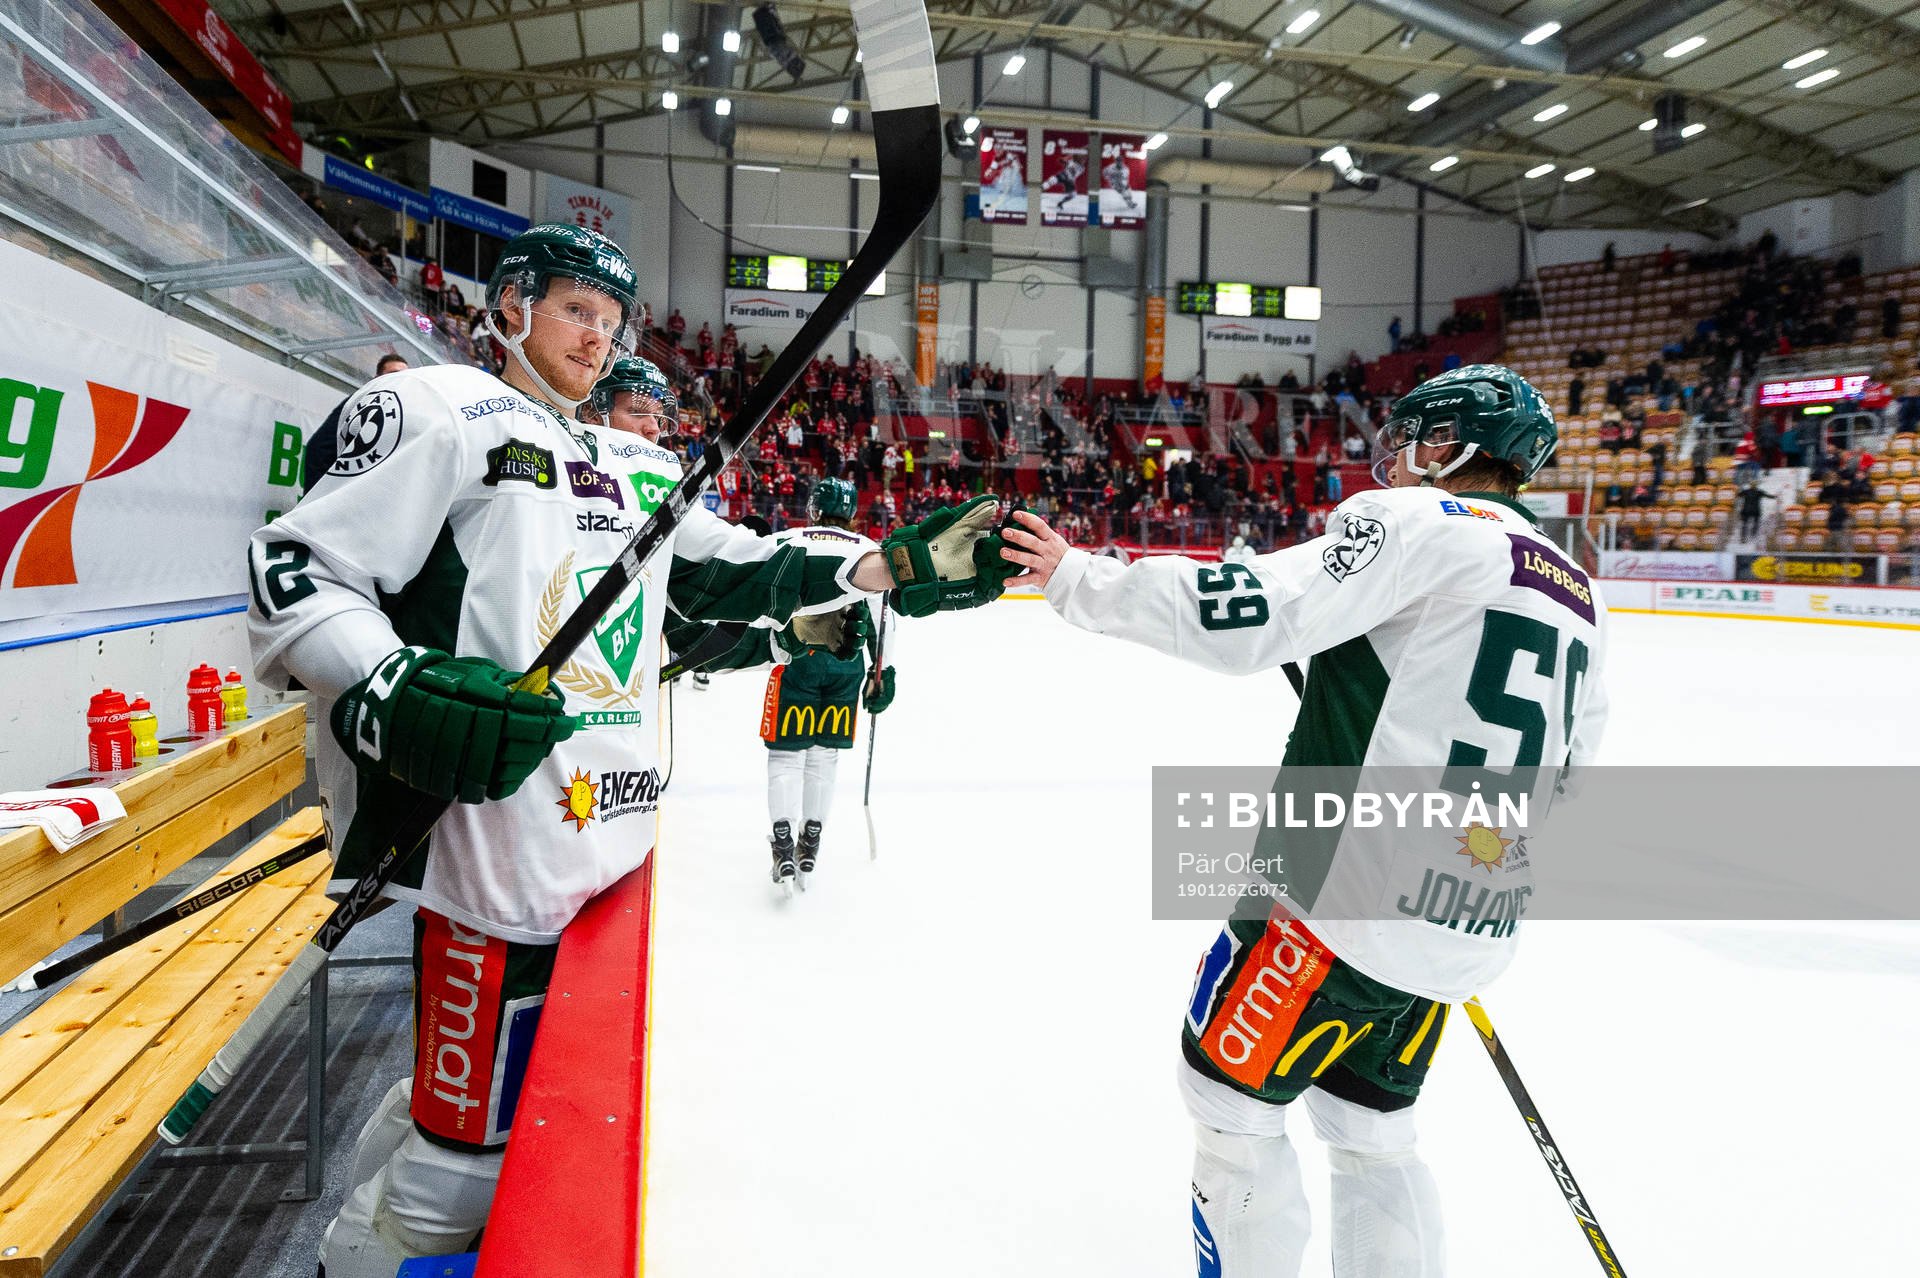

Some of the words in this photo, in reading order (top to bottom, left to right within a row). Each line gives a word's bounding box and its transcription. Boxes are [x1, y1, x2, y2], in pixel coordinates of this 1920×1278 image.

[327, 163, 382, 195] Välkommen
[503, 255, 529, 265] CCM
[730, 305, 789, 318] Faradium
[1207, 331, 1258, 342] Faradium
[1264, 333, 1292, 346] Bygg
[1295, 335, 1311, 345] AB
[1425, 396, 1464, 409] CCM
[248, 539, 318, 621] 12
[1524, 551, 1592, 606] LÖFBERGS
[1197, 563, 1269, 631] 59
[1675, 586, 1762, 601] PEAB
[207, 707, 217, 735] NERVIT
[600, 767, 660, 812] ENERG
[600, 803, 658, 824] karlstadsenergi.s
[1218, 918, 1310, 1065] armat
